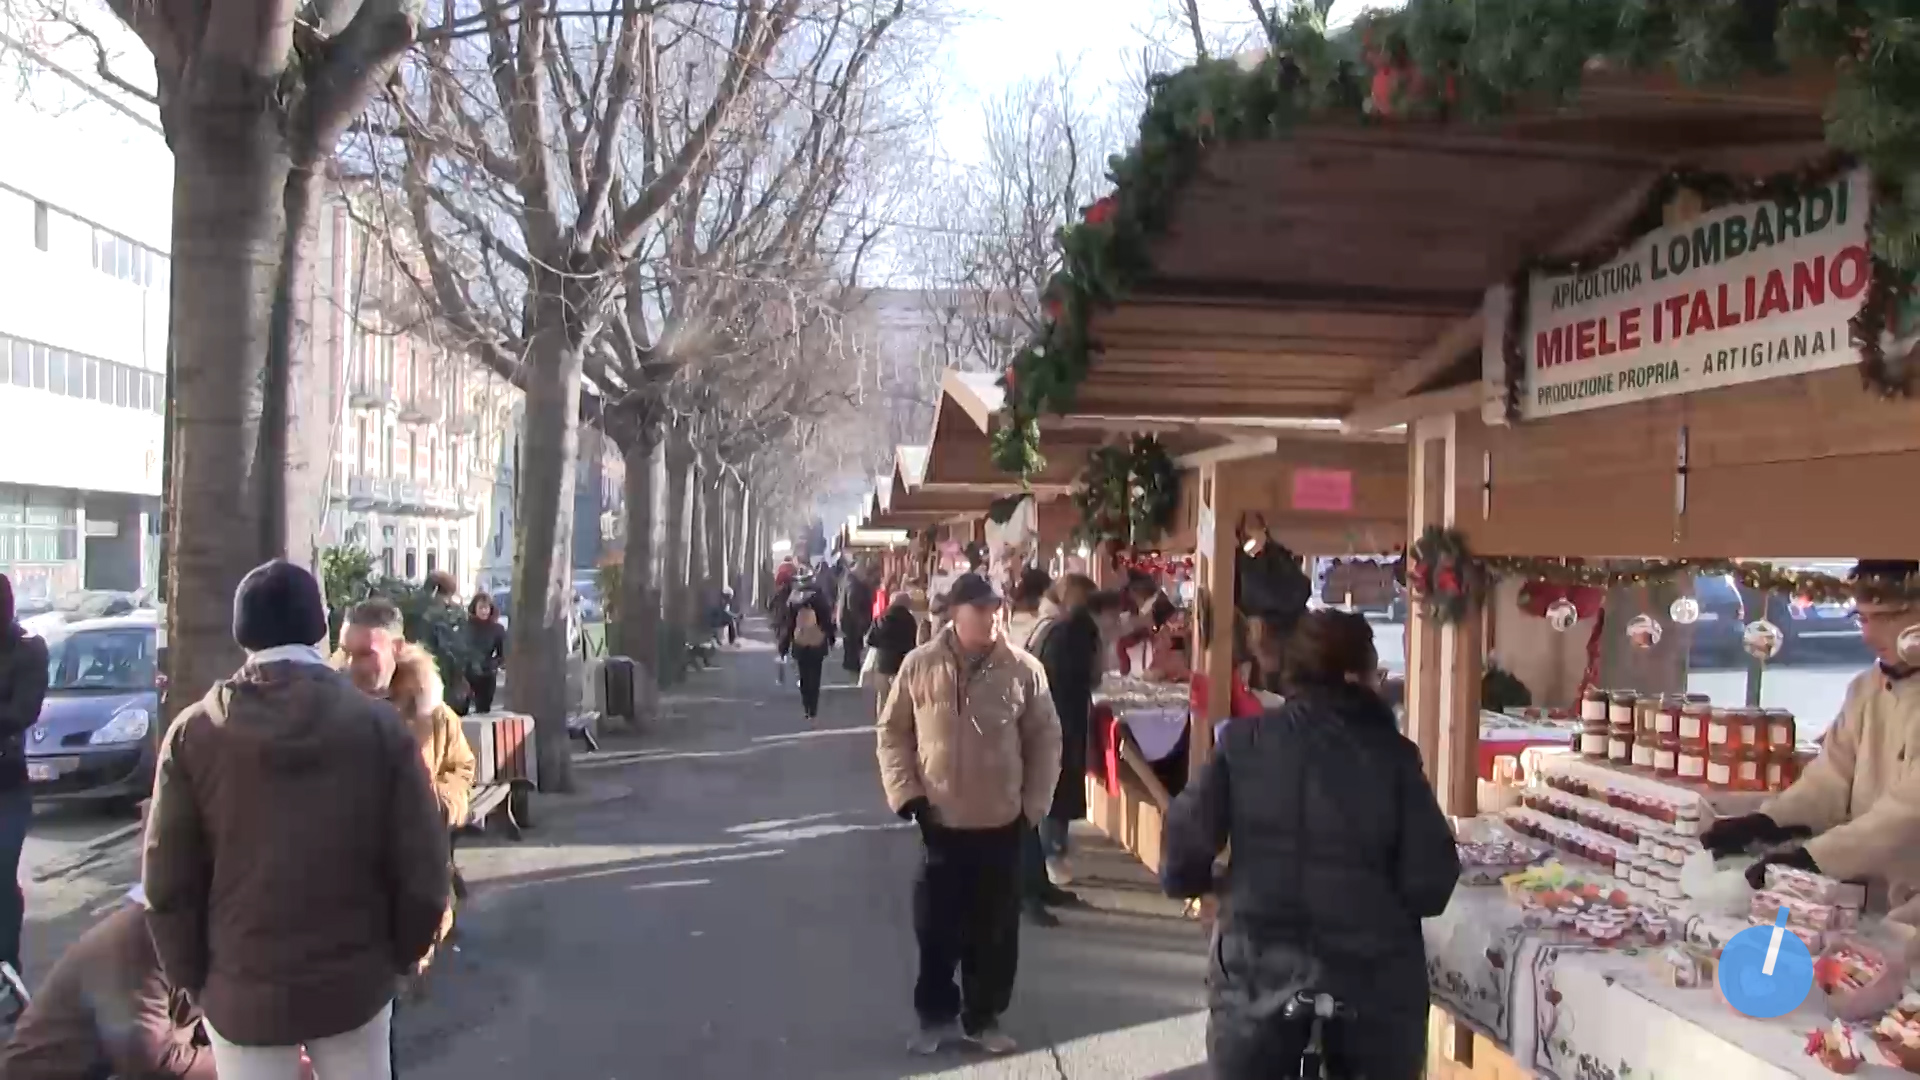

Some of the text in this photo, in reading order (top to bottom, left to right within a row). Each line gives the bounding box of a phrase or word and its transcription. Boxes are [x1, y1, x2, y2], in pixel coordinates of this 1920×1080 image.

[1651, 181, 1849, 281] LOMBARDI
[1536, 245, 1869, 369] MIELE ITALIANO
[1538, 373, 1614, 405] PRODUZIONE
[1618, 359, 1679, 392] PROPRIA
